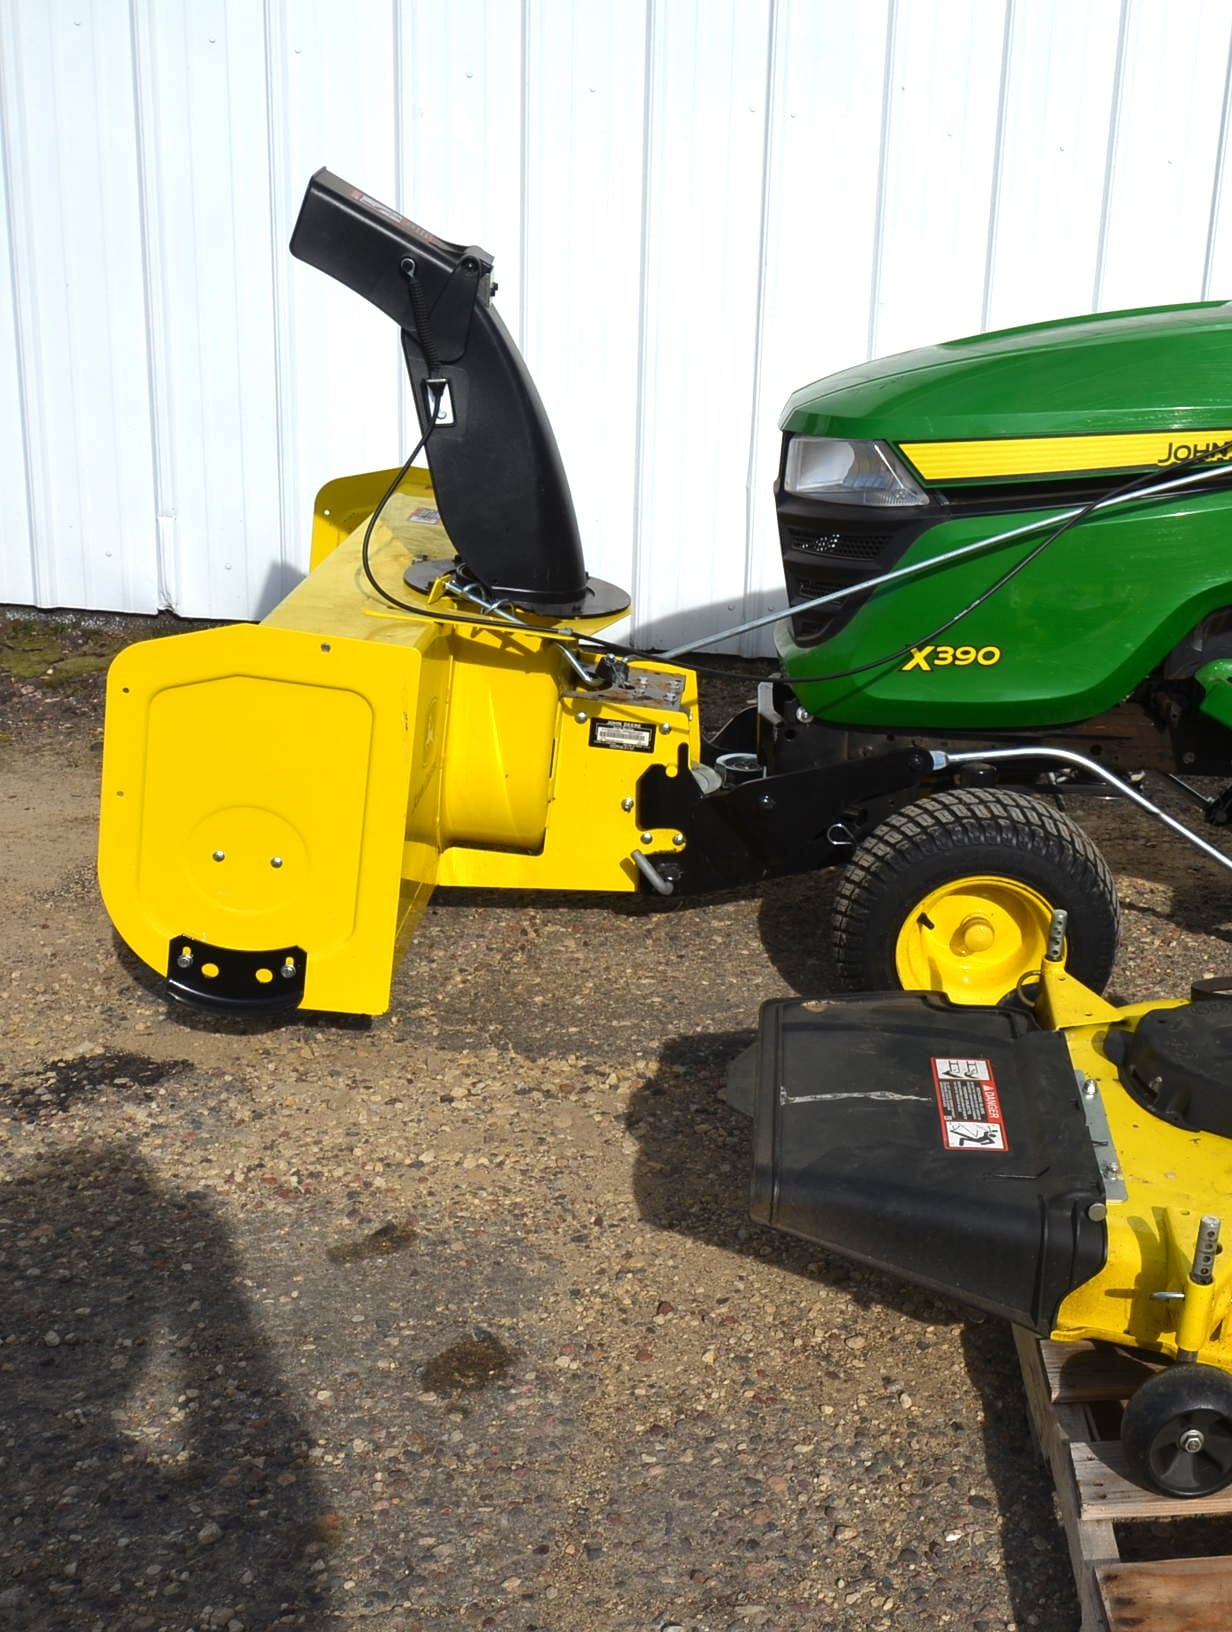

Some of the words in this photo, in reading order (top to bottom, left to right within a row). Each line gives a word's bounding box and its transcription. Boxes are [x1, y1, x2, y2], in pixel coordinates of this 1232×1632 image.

[1158, 441, 1232, 463] JOHN
[901, 645, 1001, 671] X390
[986, 1092, 1000, 1119] DANGER
